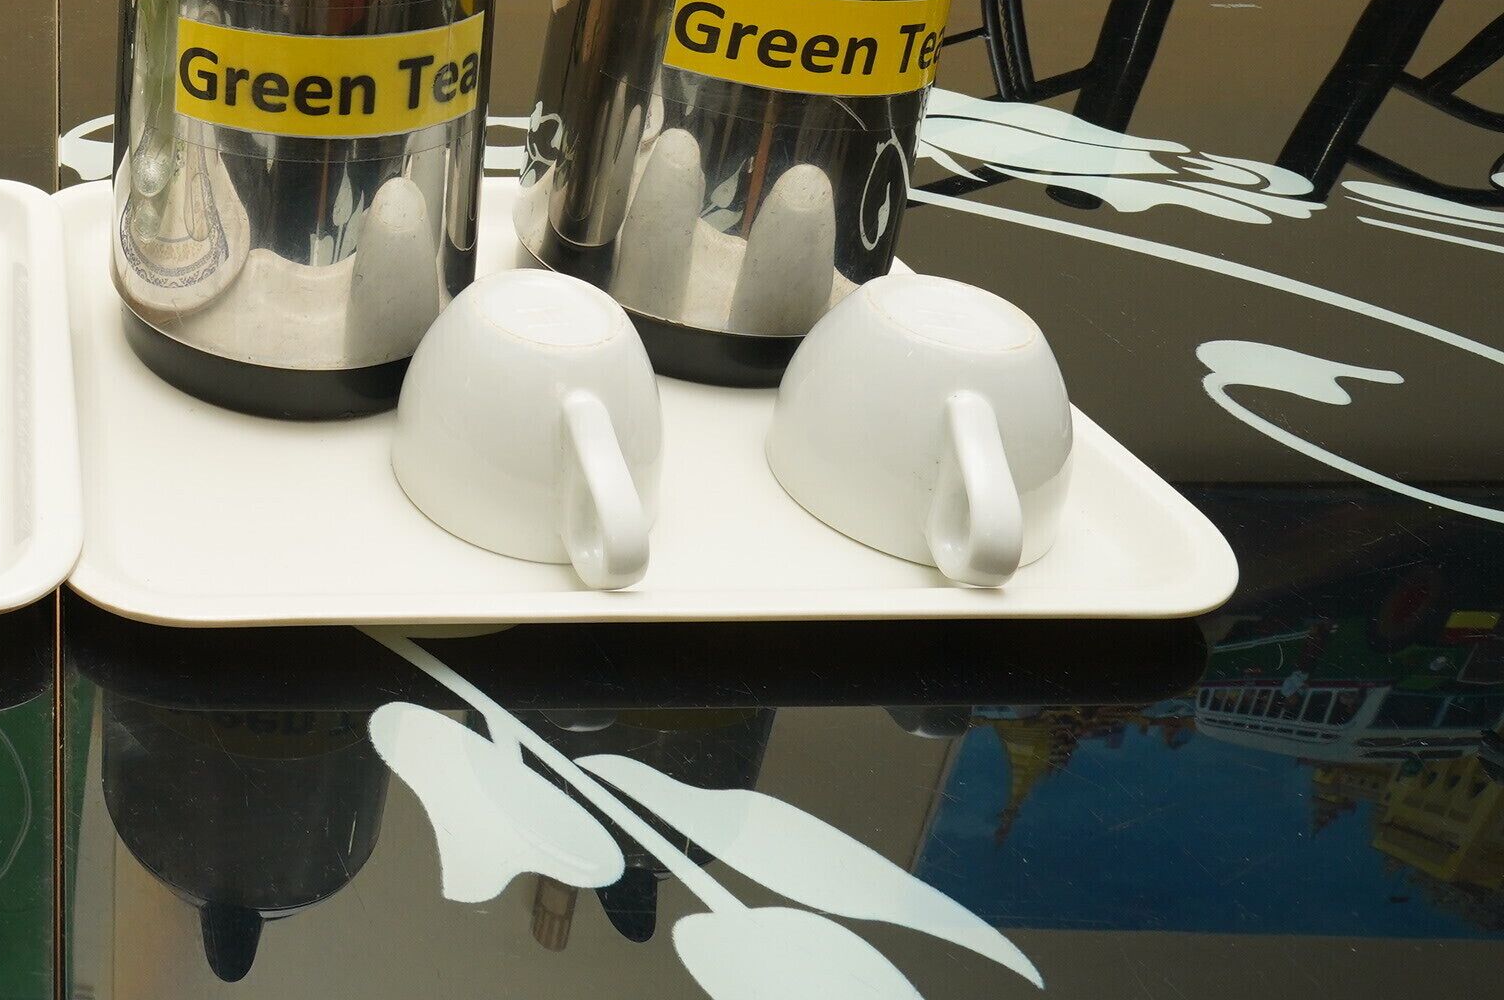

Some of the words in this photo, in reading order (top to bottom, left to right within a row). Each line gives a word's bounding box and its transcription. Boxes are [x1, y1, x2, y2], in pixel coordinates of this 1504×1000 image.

[674, 1, 879, 76] Green
[178, 46, 377, 116] Green
[398, 52, 480, 110] Tea
